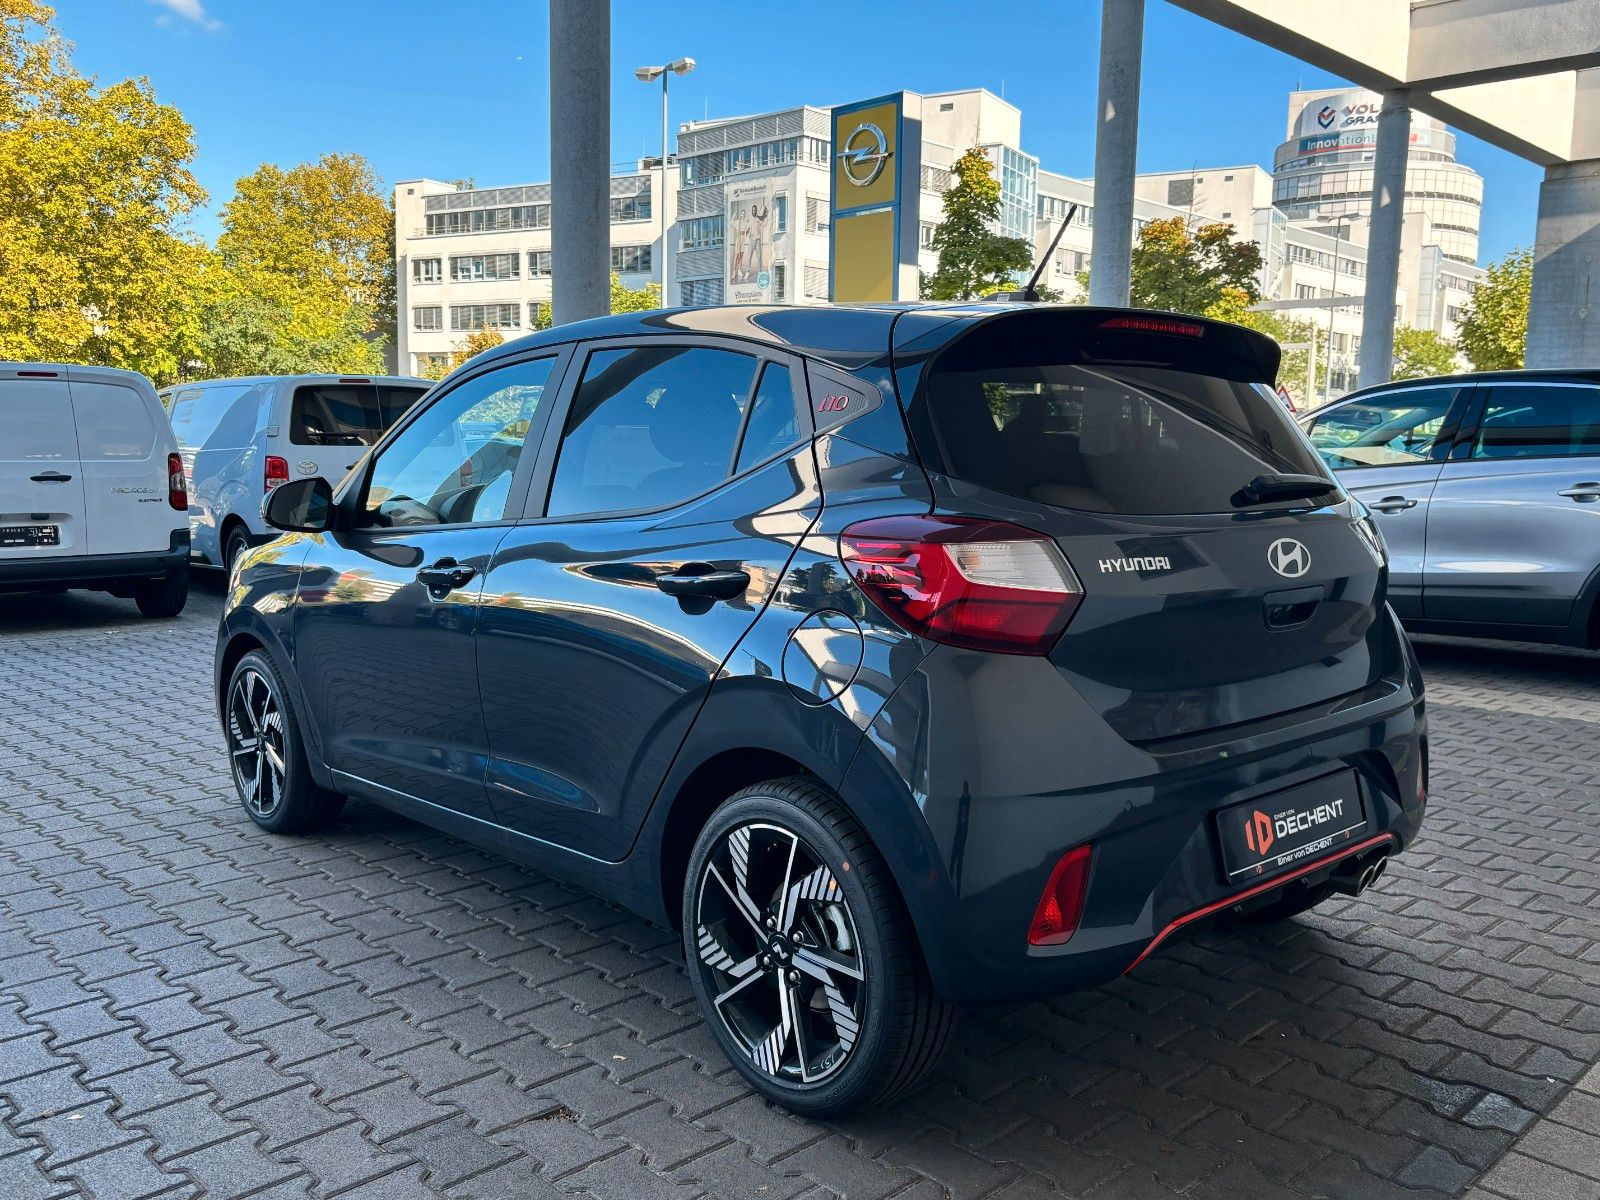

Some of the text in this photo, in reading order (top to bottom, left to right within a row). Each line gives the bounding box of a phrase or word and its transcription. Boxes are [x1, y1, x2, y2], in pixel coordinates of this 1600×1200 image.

[1346, 104, 1380, 115] VOL
[1345, 115, 1381, 126] GRA
[1307, 133, 1377, 151] InnovationL
[1098, 556, 1171, 573] HYUNDAI
[1275, 799, 1343, 839] DECHENT
[1277, 837, 1333, 866] Einer von DECHENT
